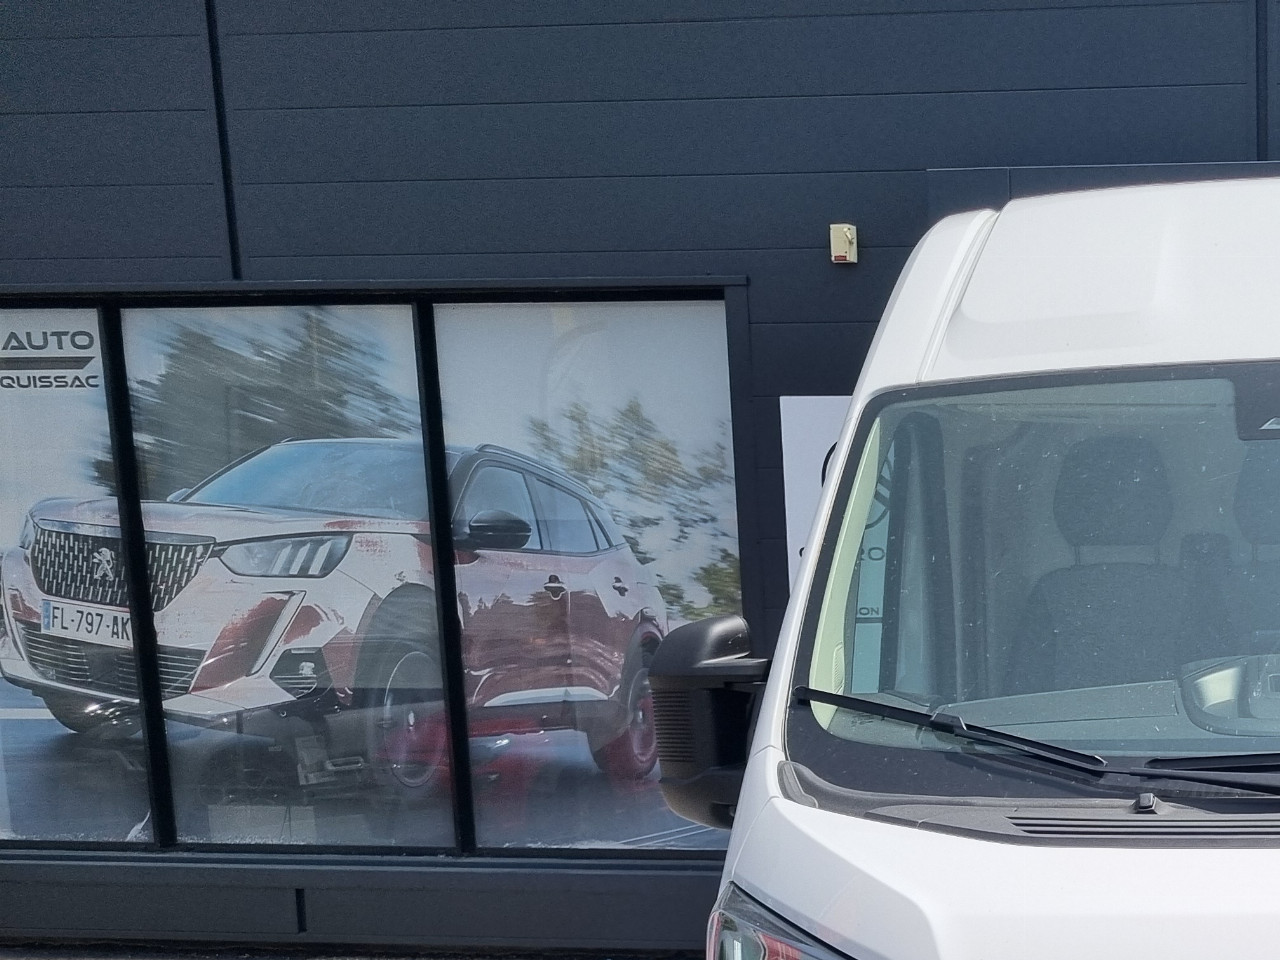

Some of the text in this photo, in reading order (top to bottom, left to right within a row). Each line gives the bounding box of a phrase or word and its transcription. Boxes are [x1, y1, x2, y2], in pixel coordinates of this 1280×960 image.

[1, 330, 95, 350] AUTO
[0, 375, 100, 388] QUISSAC
[51, 606, 131, 641] FL-797-AK
